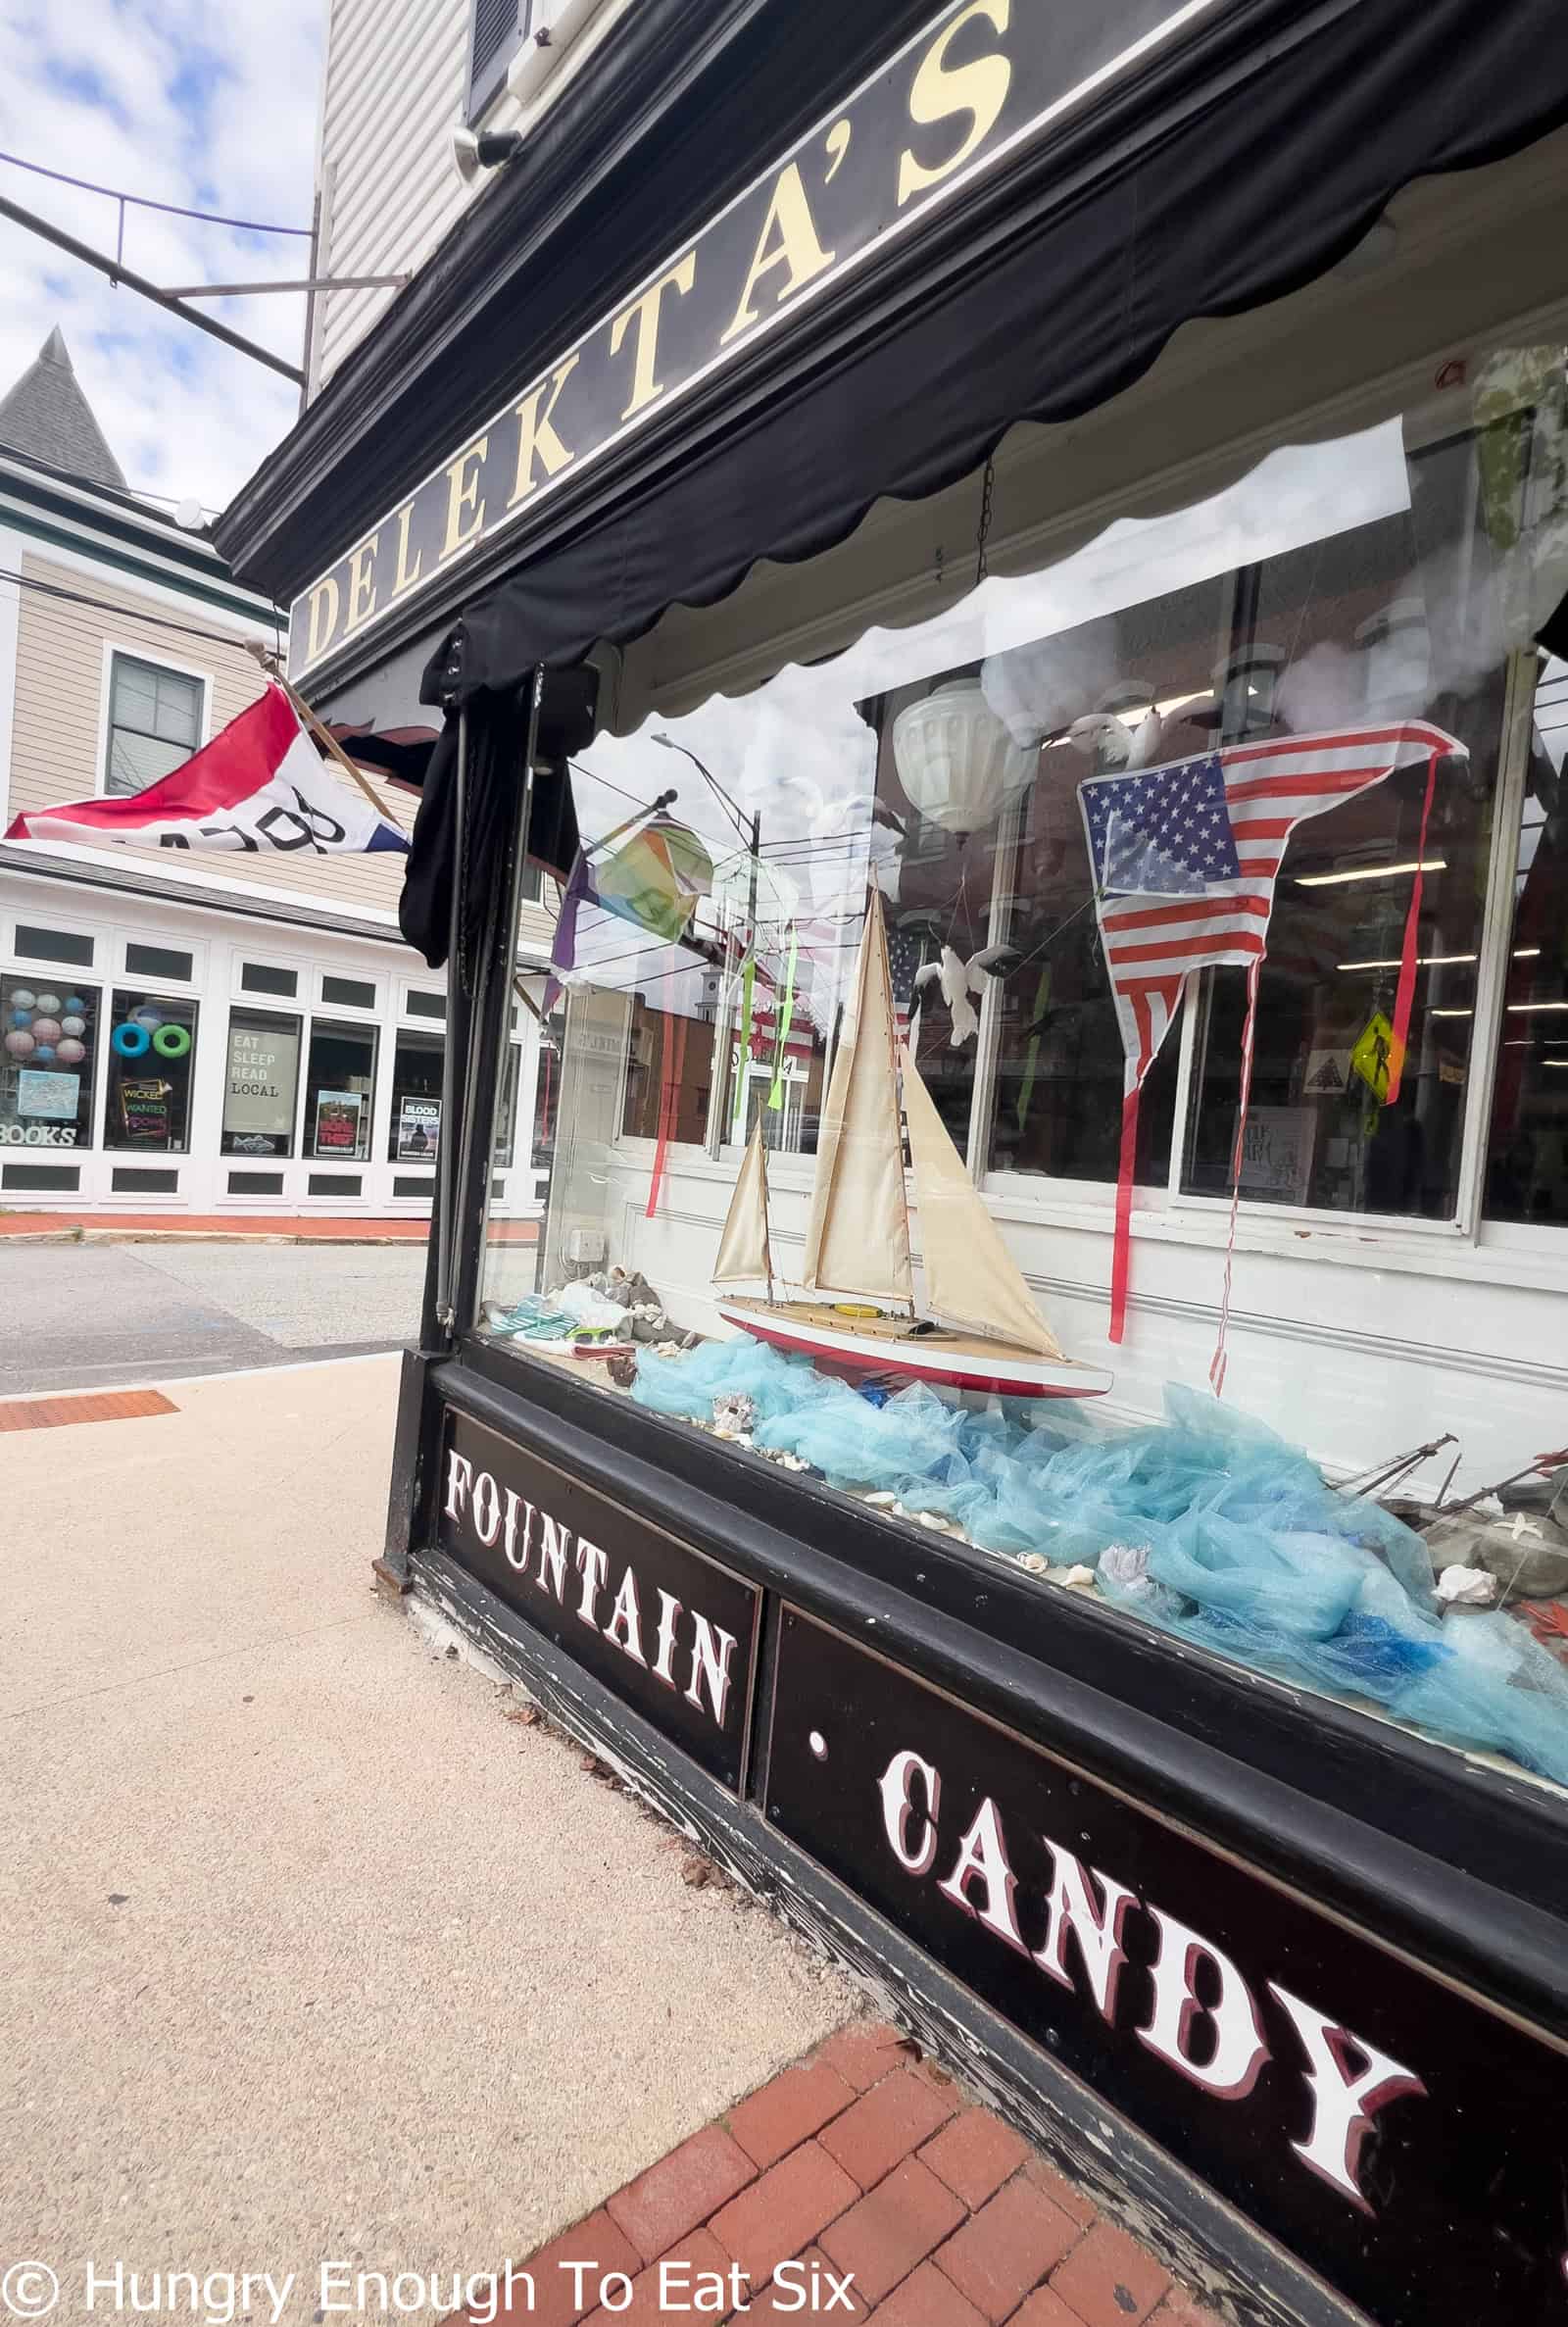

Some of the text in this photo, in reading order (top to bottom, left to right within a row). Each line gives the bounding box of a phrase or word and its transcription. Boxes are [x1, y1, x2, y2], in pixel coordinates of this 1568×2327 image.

[304, 0, 1011, 668] DELEKTA'S
[233, 1035, 260, 1050] EAT
[232, 1050, 275, 1066] SLEEP
[230, 1065, 268, 1081] READ
[230, 1082, 279, 1098] LOCAL
[405, 1105, 438, 1116] BLOOD
[444, 1450, 738, 1731] FOUNTAIN
[877, 1750, 1429, 2218] CANDY
